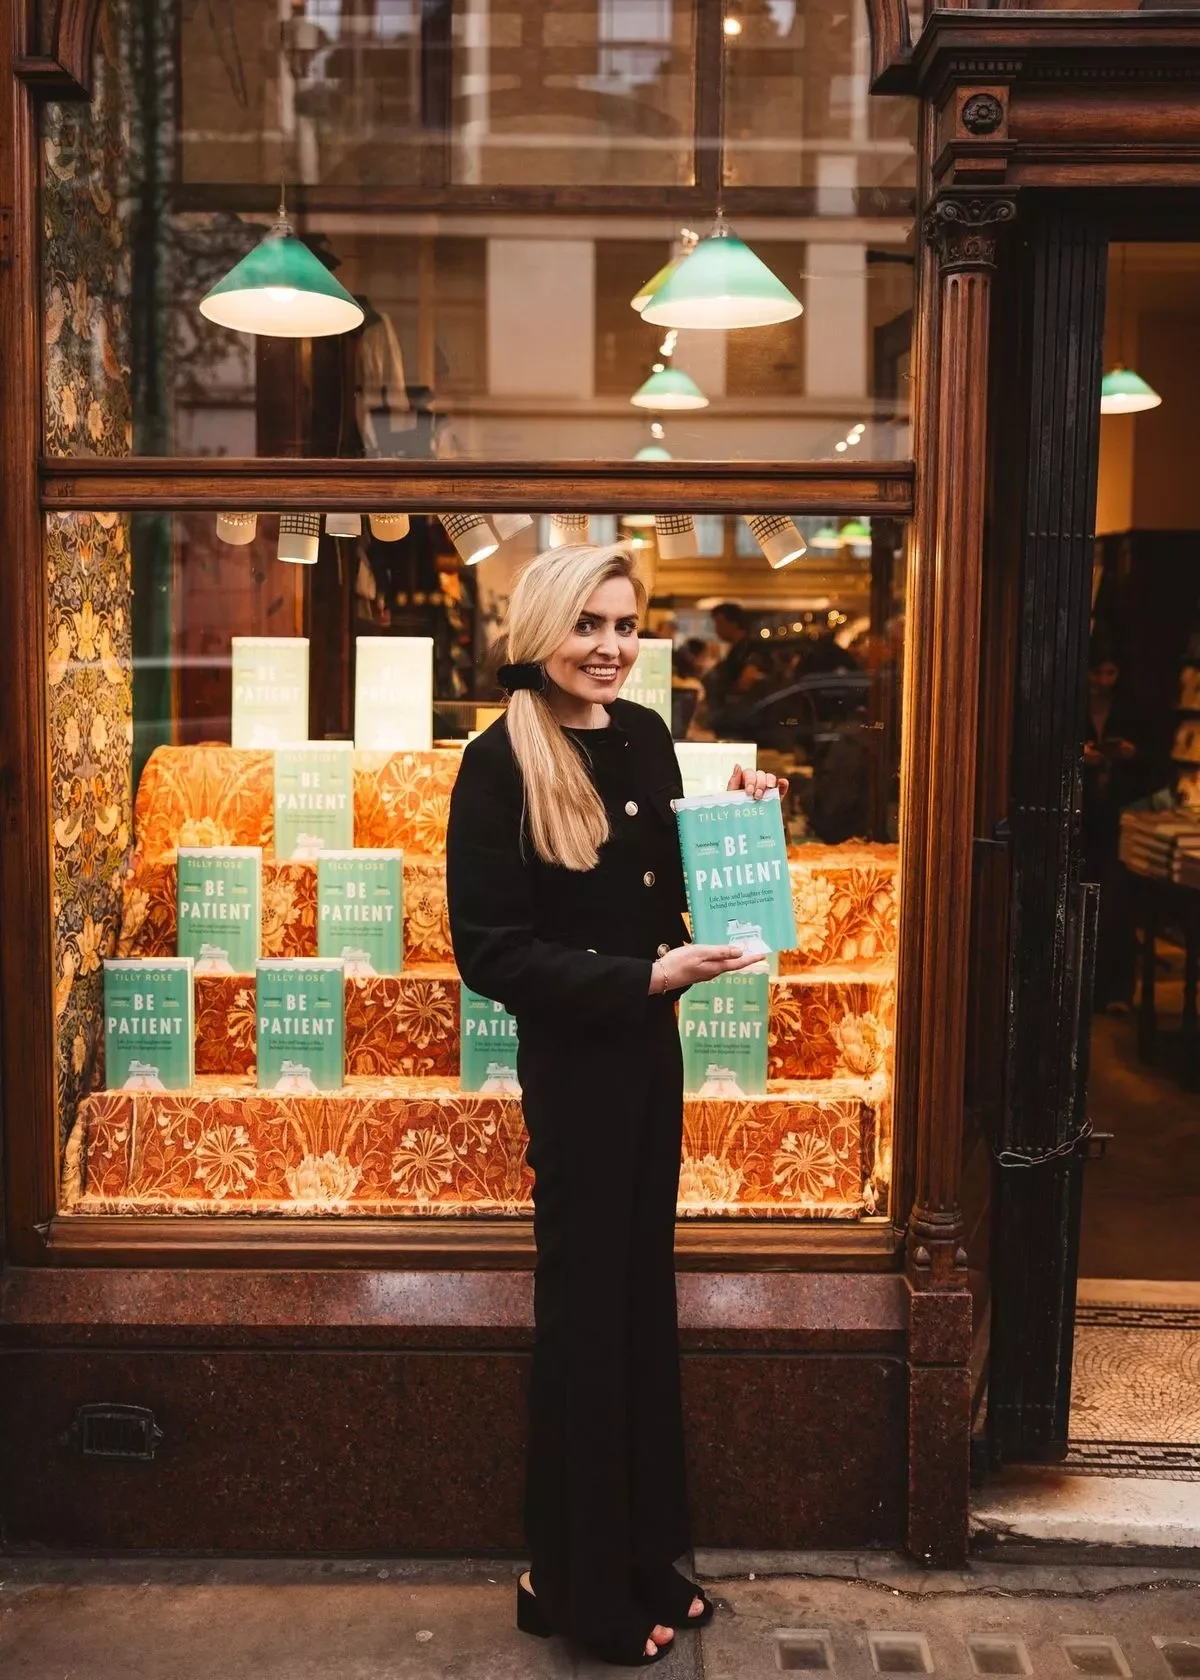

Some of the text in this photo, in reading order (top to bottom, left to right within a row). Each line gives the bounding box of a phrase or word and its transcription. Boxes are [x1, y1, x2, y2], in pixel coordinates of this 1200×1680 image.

[621, 688, 666, 704] TIENT
[301, 771, 321, 788] BE
[277, 793, 346, 810] PATIENT
[698, 806, 766, 823] TILLY ROSE
[723, 834, 748, 857] BE
[187, 860, 243, 869] TILLY ROSE
[328, 862, 385, 871] TILLY ROSE
[695, 859, 782, 891] PATIENT
[205, 880, 225, 897] BE
[346, 882, 366, 899] BE
[180, 902, 251, 920] PATIENT
[321, 904, 393, 922] PATIENT
[115, 973, 173, 982] TILLY ROSE
[267, 973, 325, 982] TILLY ROSE
[726, 976, 755, 986] ROSE
[134, 993, 154, 1011] BE
[286, 993, 307, 1011] BE
[713, 997, 735, 1015] BE
[108, 1017, 182, 1035] PATIENT
[260, 1017, 335, 1035] PATIENT
[465, 1019, 517, 1036] PATIE
[685, 1020, 762, 1039] PATIENT
